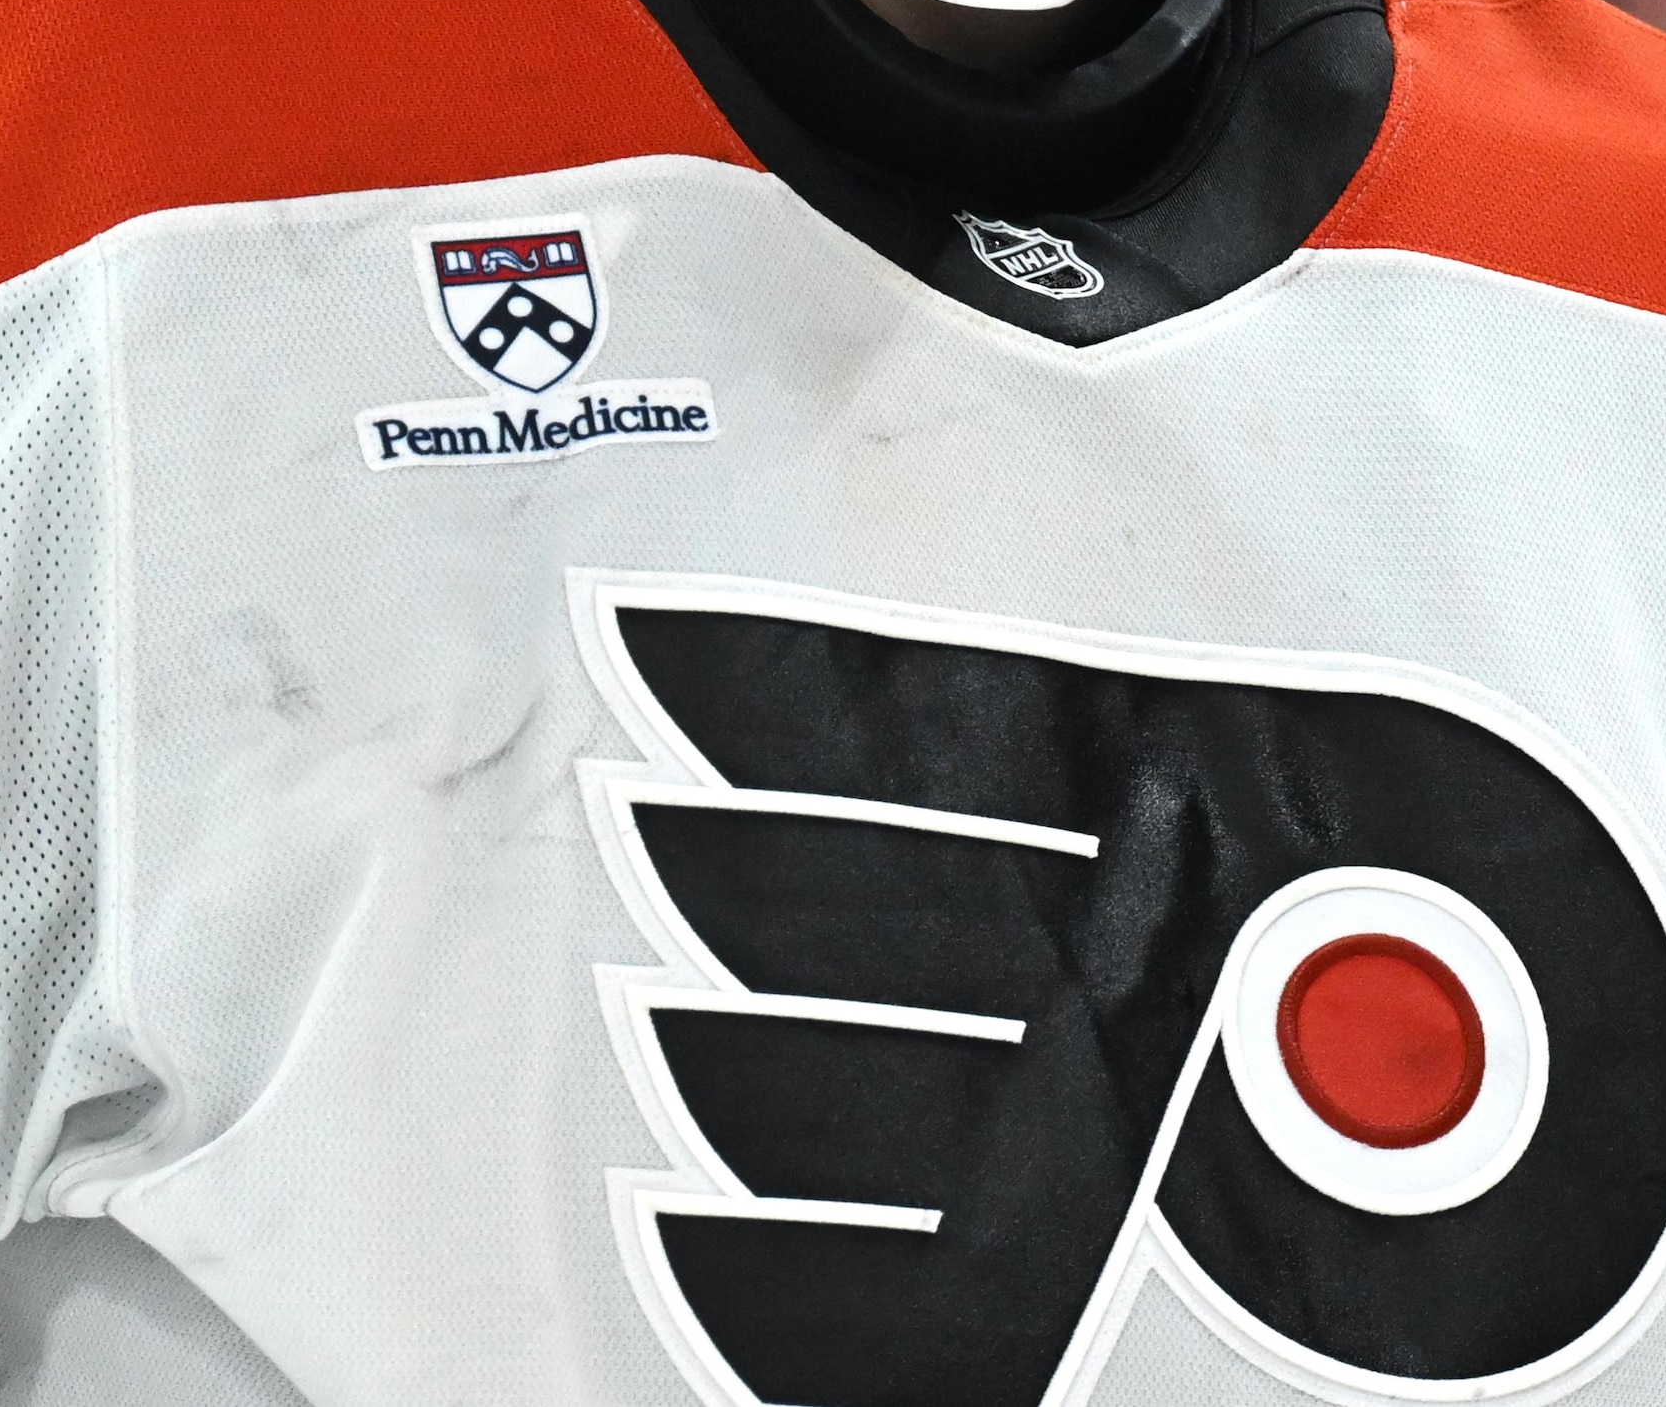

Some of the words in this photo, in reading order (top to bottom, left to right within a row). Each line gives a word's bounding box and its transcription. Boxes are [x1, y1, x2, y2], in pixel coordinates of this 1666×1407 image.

[999, 245, 1060, 276] NHL
[372, 418, 493, 461] Penn
[492, 394, 709, 454] Medicine
